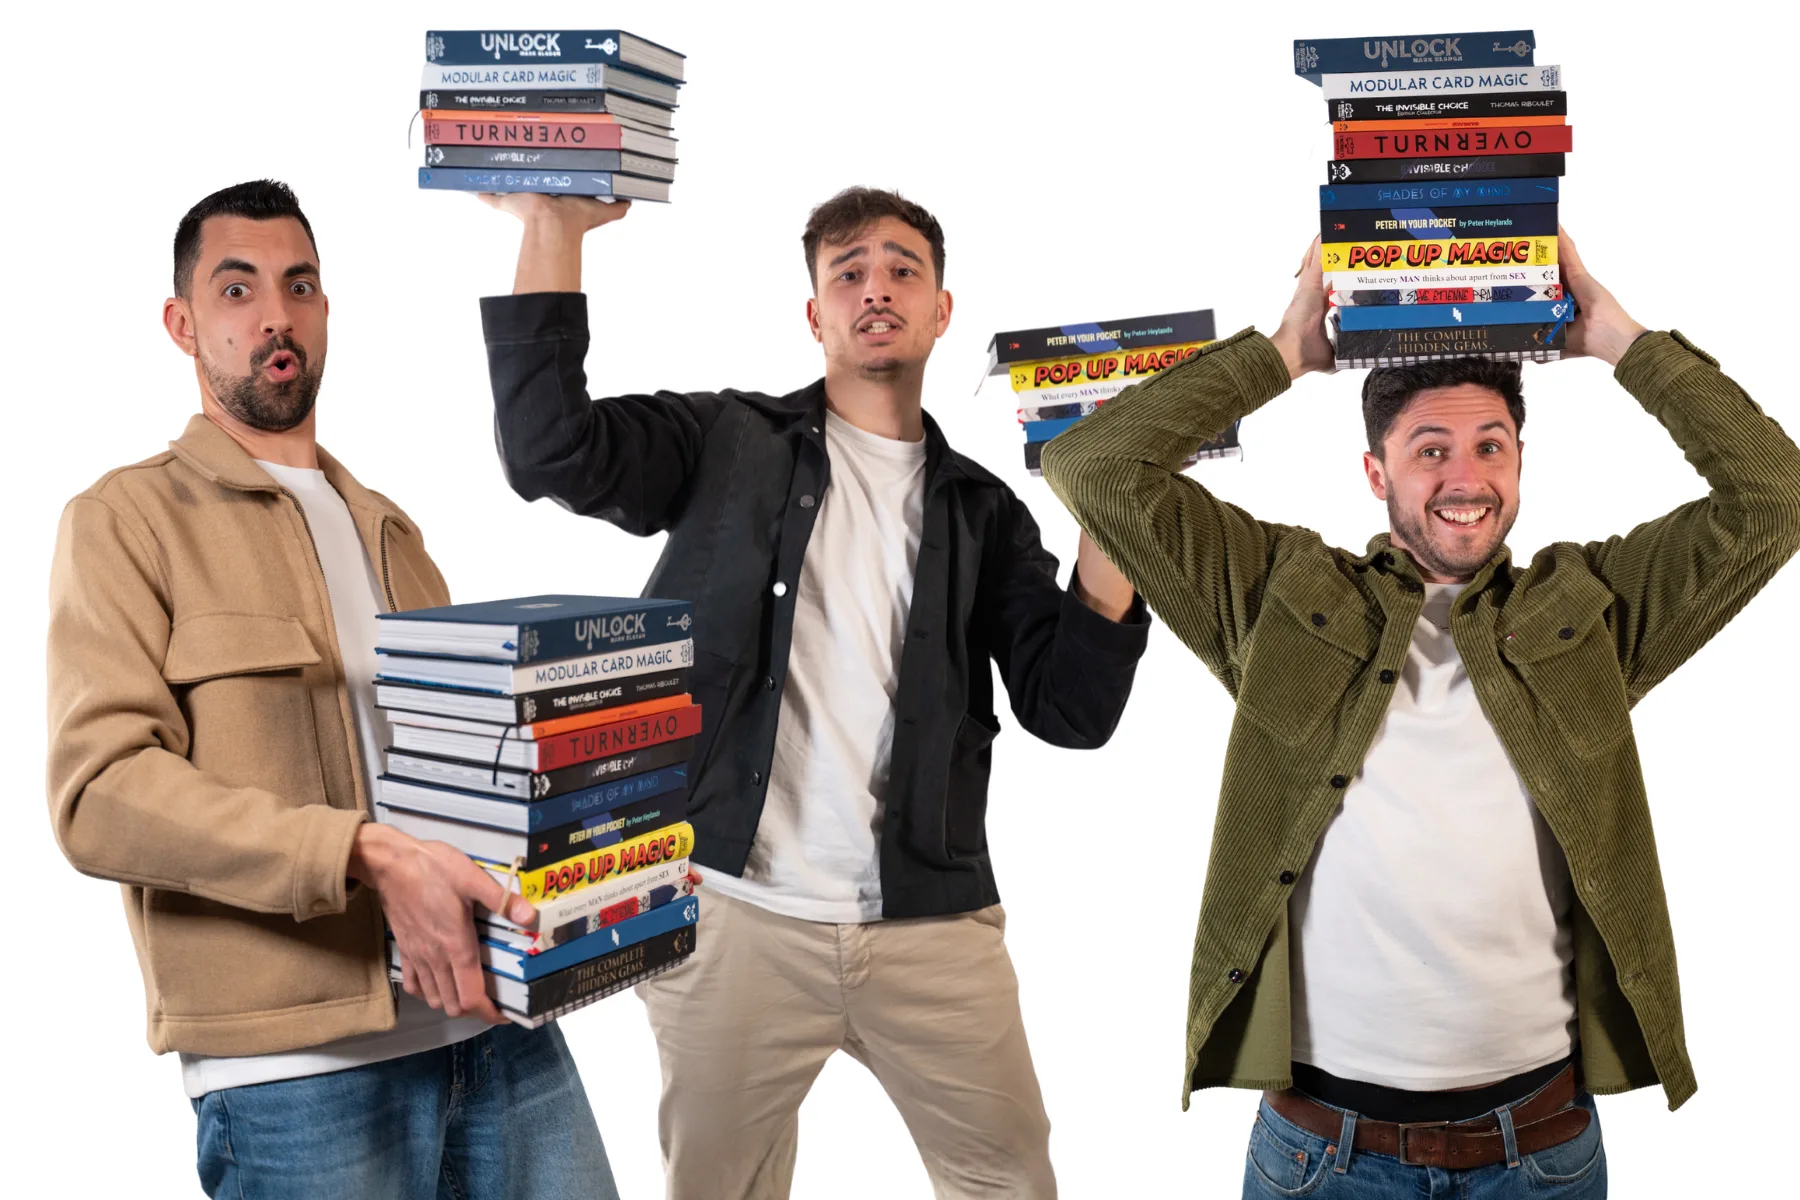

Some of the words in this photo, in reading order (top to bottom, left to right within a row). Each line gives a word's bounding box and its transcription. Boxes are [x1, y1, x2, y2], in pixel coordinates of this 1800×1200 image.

[481, 33, 561, 60] UNLOCK
[1363, 38, 1463, 68] UNLOCK
[441, 71, 499, 84] MODULAR
[503, 71, 535, 83] CARD
[538, 70, 577, 82] MAGIC
[1350, 77, 1428, 93] MODULAR
[1432, 75, 1474, 89] CARD
[1479, 73, 1529, 87] MAGIC
[454, 96, 468, 104] THE
[1395, 103, 1436, 112] INVISIBLE
[1438, 102, 1469, 110] CHOICE
[1378, 188, 1424, 201] SHADES
[1429, 187, 1449, 199] OF
[1453, 187, 1471, 197] MY
[1476, 185, 1511, 197] MIND
[1375, 220, 1398, 230] PETER
[1399, 220, 1407, 229] IN
[1408, 219, 1427, 229] YOUR
[1429, 218, 1457, 228] POCKET
[1459, 220, 1466, 228] by
[1467, 219, 1484, 227] Peter
[1484, 218, 1513, 227] Heylands
[1348, 245, 1402, 269] POP
[1406, 243, 1442, 267] UP
[1447, 241, 1530, 265] MAGIC
[1357, 276, 1377, 284] What
[1379, 277, 1398, 285] every
[1400, 275, 1420, 283] MAN
[1448, 274, 1467, 282] about
[1469, 275, 1488, 283] apart
[1490, 273, 1508, 281] from
[1509, 272, 1526, 280] SEX
[1047, 336, 1067, 347] PETER
[1068, 335, 1077, 344] IN
[1077, 333, 1096, 343] YOUR
[1096, 330, 1121, 342] POCKET
[1124, 331, 1131, 339] by
[1132, 329, 1147, 337] Peter
[1397, 332, 1420, 343] THE
[1424, 329, 1488, 341] COMPLETE
[1398, 342, 1450, 354] HIDDEN
[1454, 341, 1488, 351] GEMS
[1034, 362, 1082, 387] POP
[1085, 357, 1118, 379] UP
[1041, 391, 1061, 402] What
[1061, 390, 1079, 401] every
[1079, 387, 1099, 398] MAN
[575, 612, 647, 651] UNLOCK
[535, 663, 598, 684] MODULAR
[601, 657, 633, 674] CARD
[636, 649, 673, 668] MAGIC
[553, 697, 568, 708] THE
[599, 686, 623, 699] CHOICE
[606, 786, 620, 801] OF
[569, 829, 586, 845] PETER
[585, 828, 592, 841] IN
[592, 823, 606, 838] YOUR
[605, 817, 626, 833] POCKET
[626, 818, 632, 828] by
[631, 814, 643, 825] Peter
[541, 861, 586, 899] POP
[588, 853, 616, 884] UP
[616, 834, 677, 875] MAGIC
[558, 907, 573, 918] What
[573, 902, 587, 914] every
[588, 896, 603, 908] MAN
[619, 886, 634, 897] about
[659, 870, 670, 881] SEX
[576, 966, 596, 982] THE
[597, 946, 645, 974] COMPLETE
[576, 972, 616, 995] HIDDEN
[618, 960, 645, 978] GEMS
